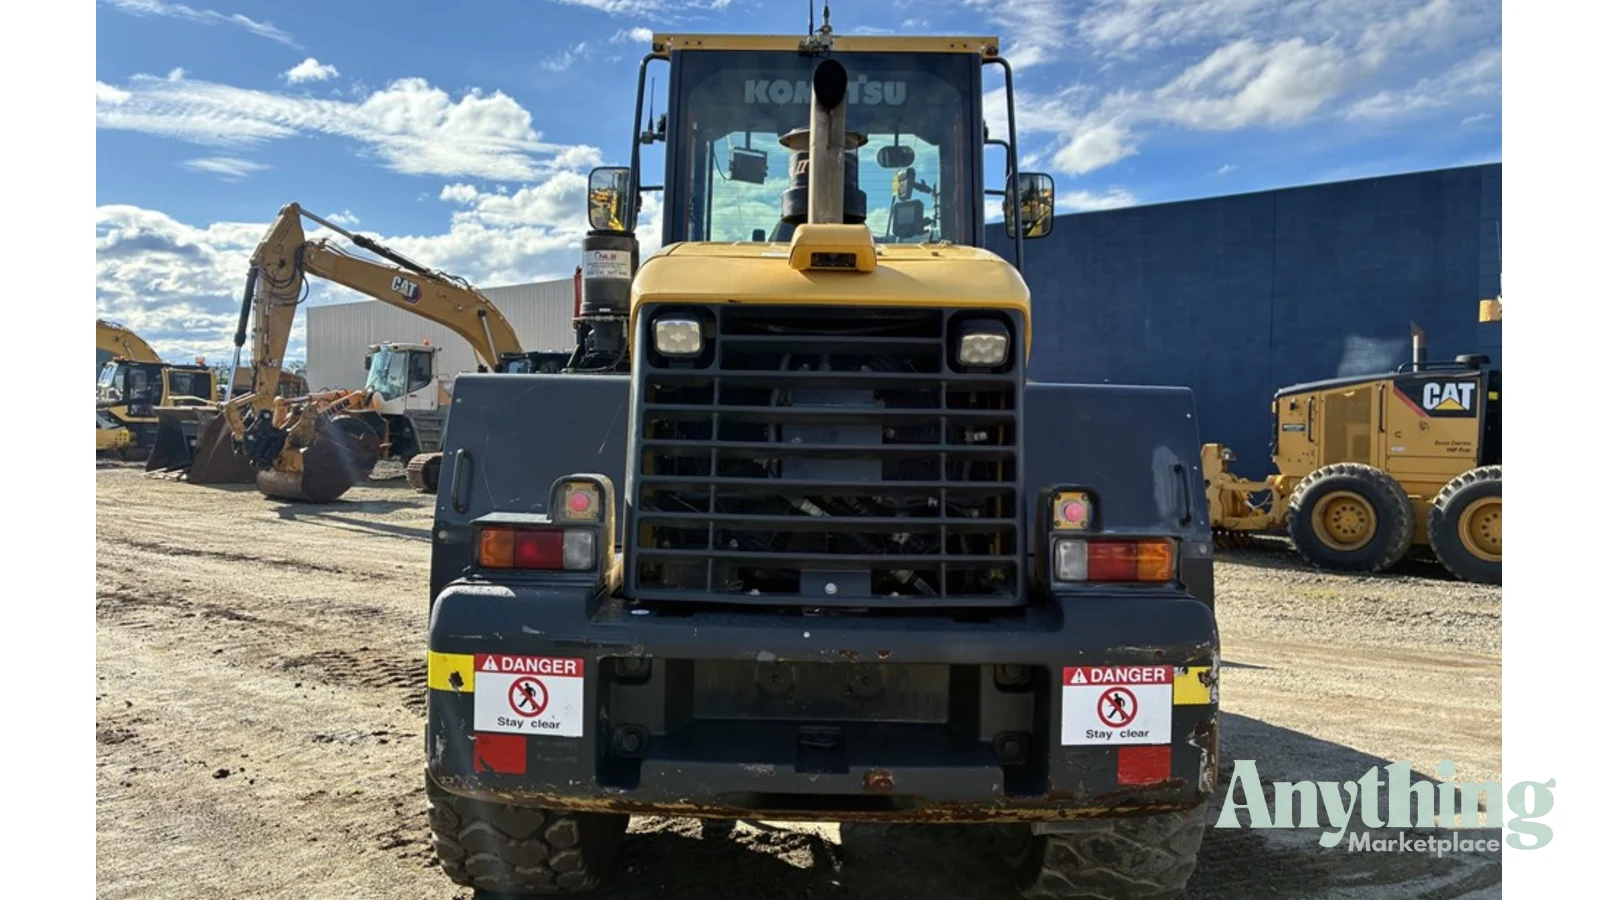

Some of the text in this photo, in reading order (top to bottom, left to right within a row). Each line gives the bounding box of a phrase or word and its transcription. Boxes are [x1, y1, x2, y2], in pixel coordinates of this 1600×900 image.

[744, 74, 907, 106] KOMTSU
[391, 275, 418, 299] CAT
[1422, 382, 1476, 411] CAT
[501, 656, 577, 675] DANGER
[1091, 667, 1166, 683] DANGER
[497, 716, 561, 730] Stay clear
[1085, 728, 1150, 741] Stay clear
